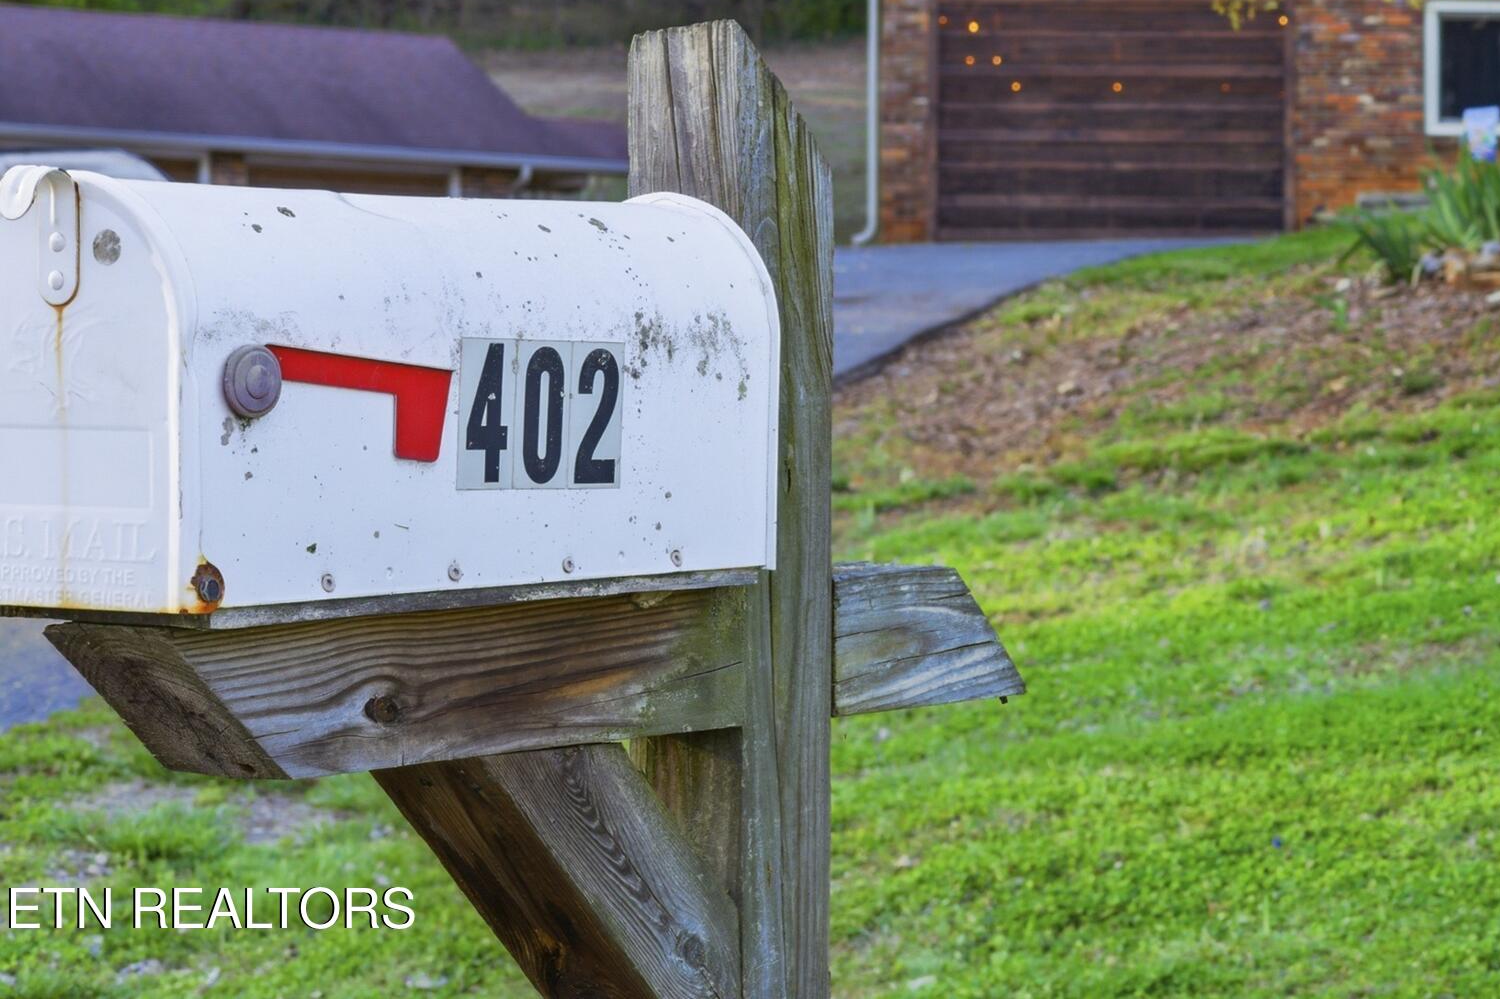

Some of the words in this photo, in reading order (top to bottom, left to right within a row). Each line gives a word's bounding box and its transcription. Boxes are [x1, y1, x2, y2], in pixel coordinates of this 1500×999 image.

[466, 343, 619, 484] 402
[40, 517, 159, 564] MAIL
[101, 567, 137, 587] THE
